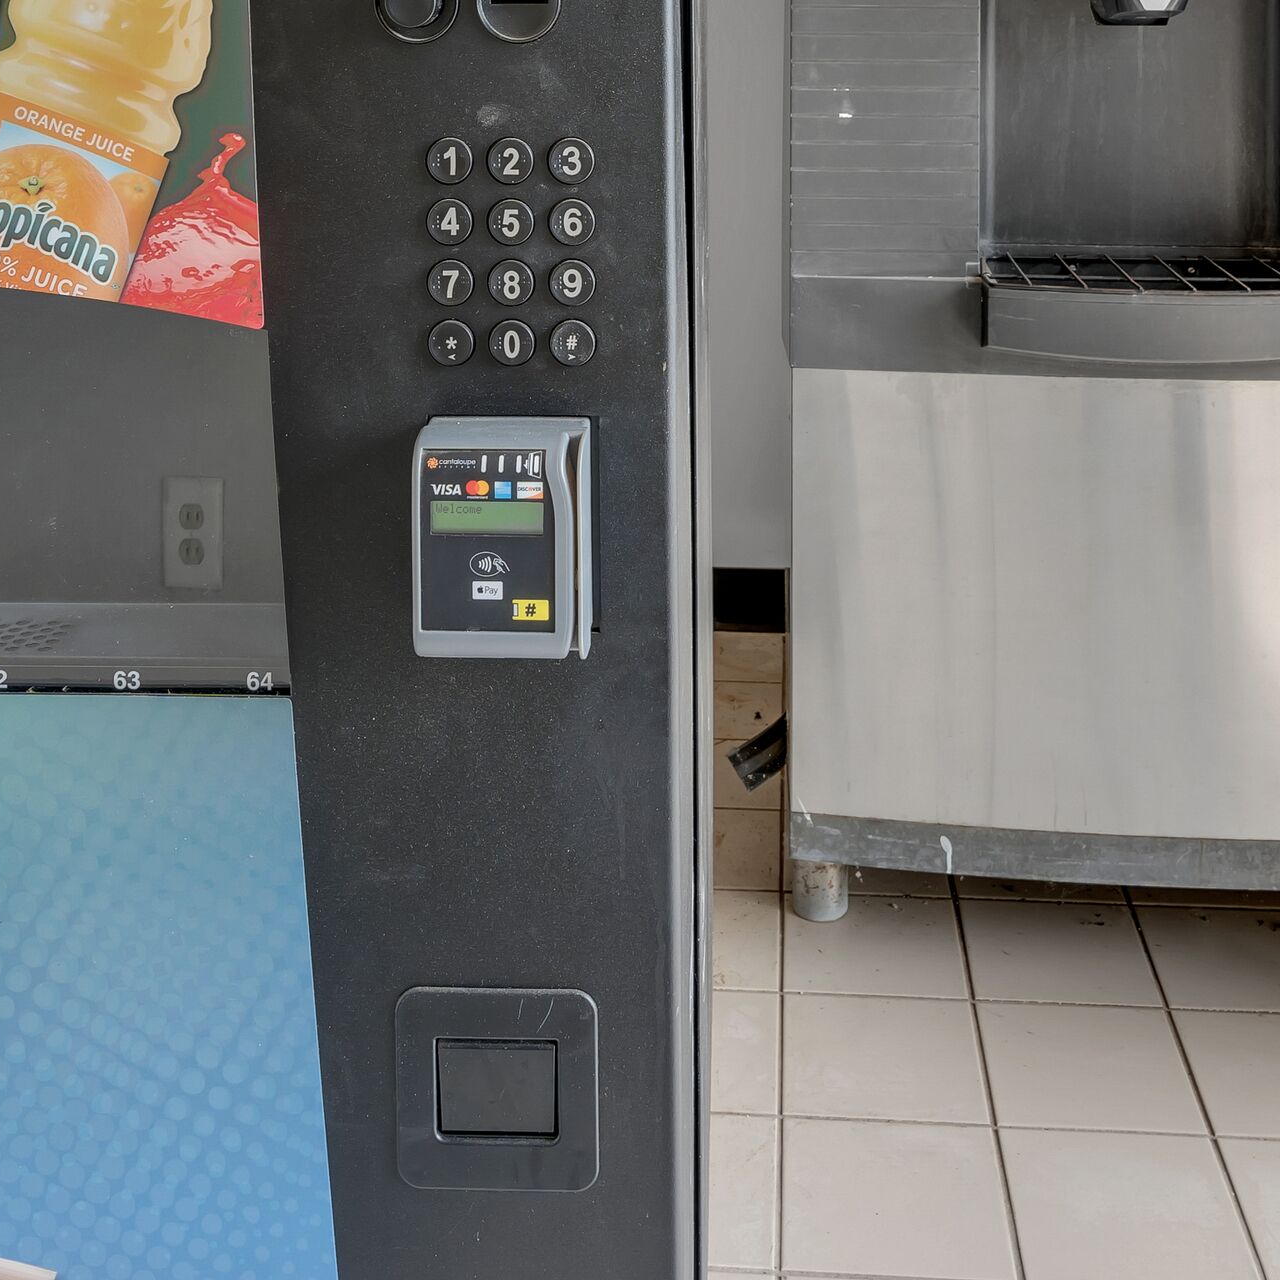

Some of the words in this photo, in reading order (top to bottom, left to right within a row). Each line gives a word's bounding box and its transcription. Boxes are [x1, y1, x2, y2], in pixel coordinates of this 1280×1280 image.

[14, 106, 86, 142] ORANGE
[86, 133, 135, 162] JUICE
[443, 146, 456, 176] 1
[502, 147, 520, 176] 2
[562, 146, 582, 176] 3
[441, 207, 459, 236] 4
[501, 209, 520, 238] 5
[563, 208, 582, 236] 6
[21, 266, 88, 296] JUICE
[442, 270, 459, 298] 7
[503, 270, 520, 299] 8
[562, 269, 582, 298] 9
[503, 330, 520, 359] 0
[430, 484, 462, 496] VISA
[435, 504, 482, 514] Welcome
[112, 670, 141, 690] 63
[246, 671, 274, 690] 64
